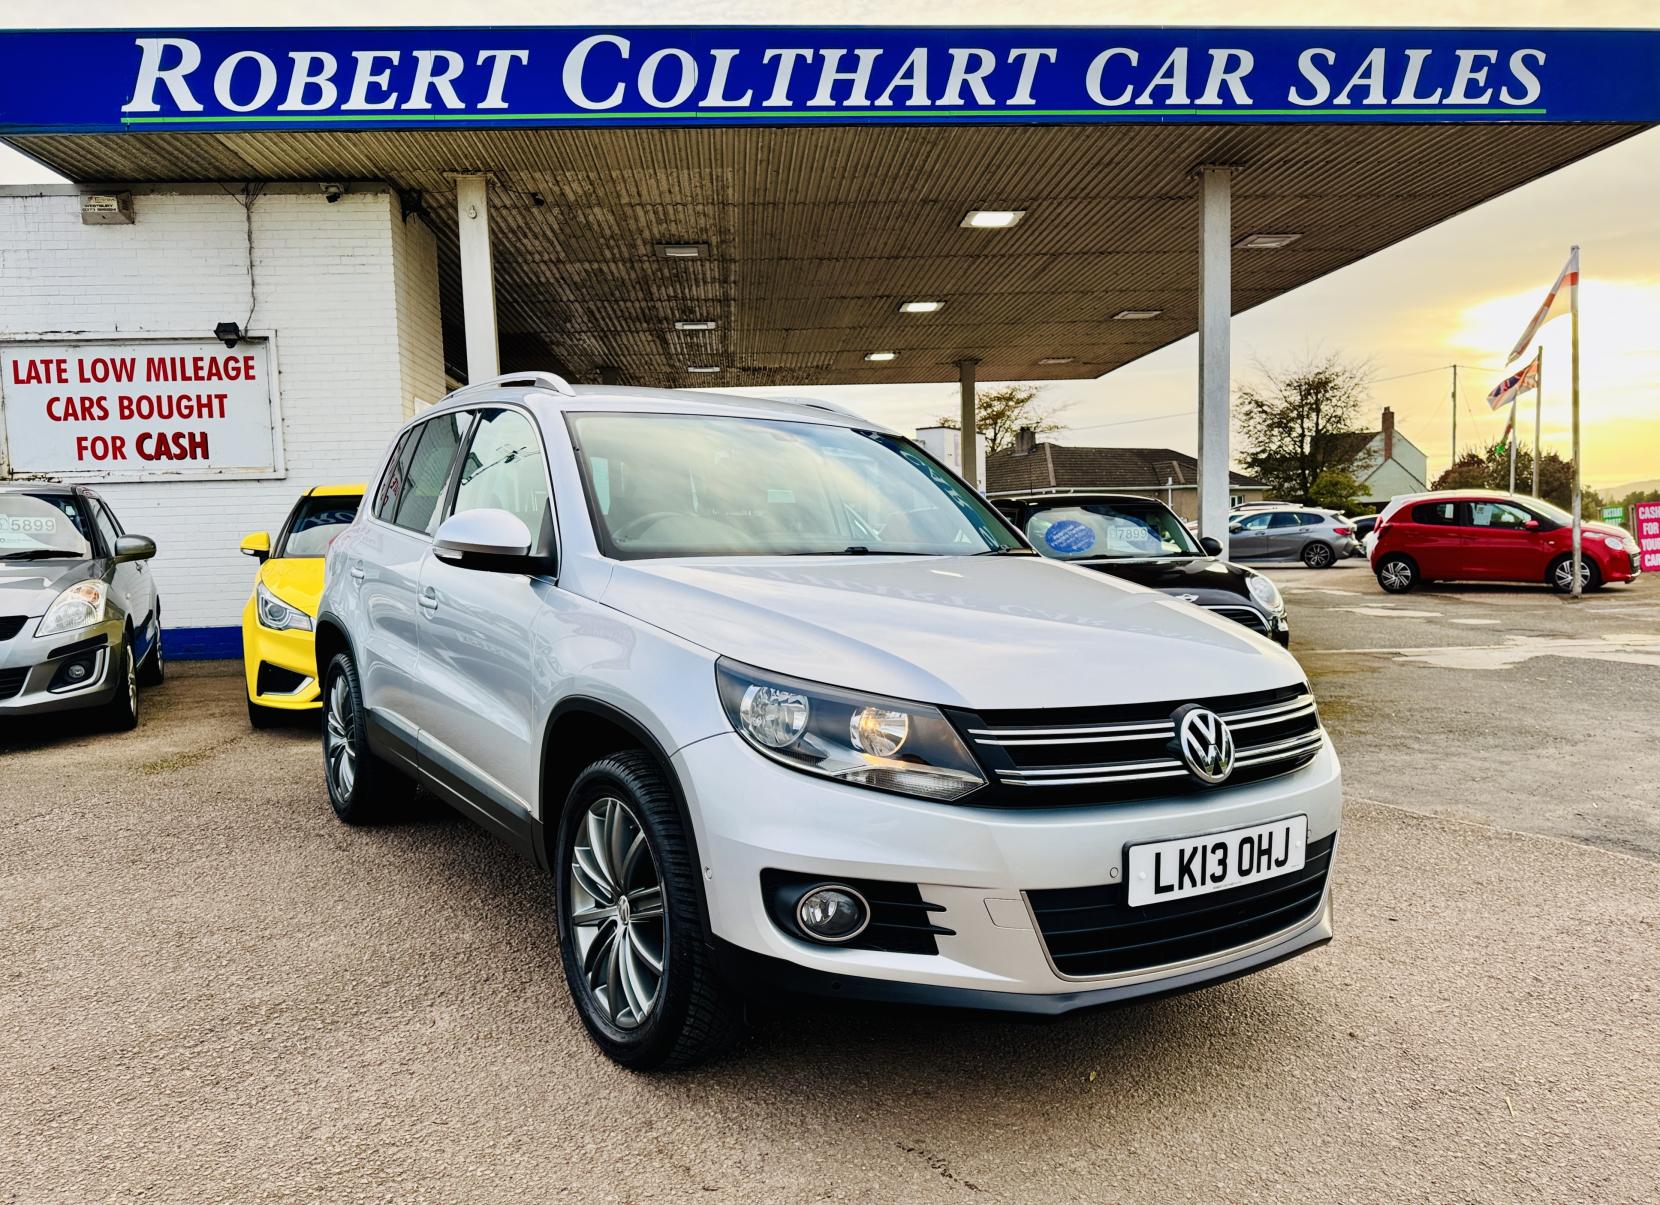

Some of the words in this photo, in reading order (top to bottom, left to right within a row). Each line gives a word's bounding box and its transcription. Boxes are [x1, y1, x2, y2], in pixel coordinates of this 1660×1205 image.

[121, 37, 529, 114] ROBERT
[562, 34, 1058, 111] COLTHART
[1086, 47, 1255, 107] CAR
[1288, 47, 1547, 107] SALES
[12, 358, 68, 385] LATE
[78, 357, 136, 383] LOW
[146, 356, 256, 382] MILEAGE
[46, 395, 109, 421] CARS
[118, 394, 228, 420] BOUGHT
[76, 435, 127, 461] FOR
[135, 431, 209, 461] CASH
[11, 519, 55, 532] 5899
[1643, 522, 1659, 535] FOR
[1154, 841, 1228, 895] LK13
